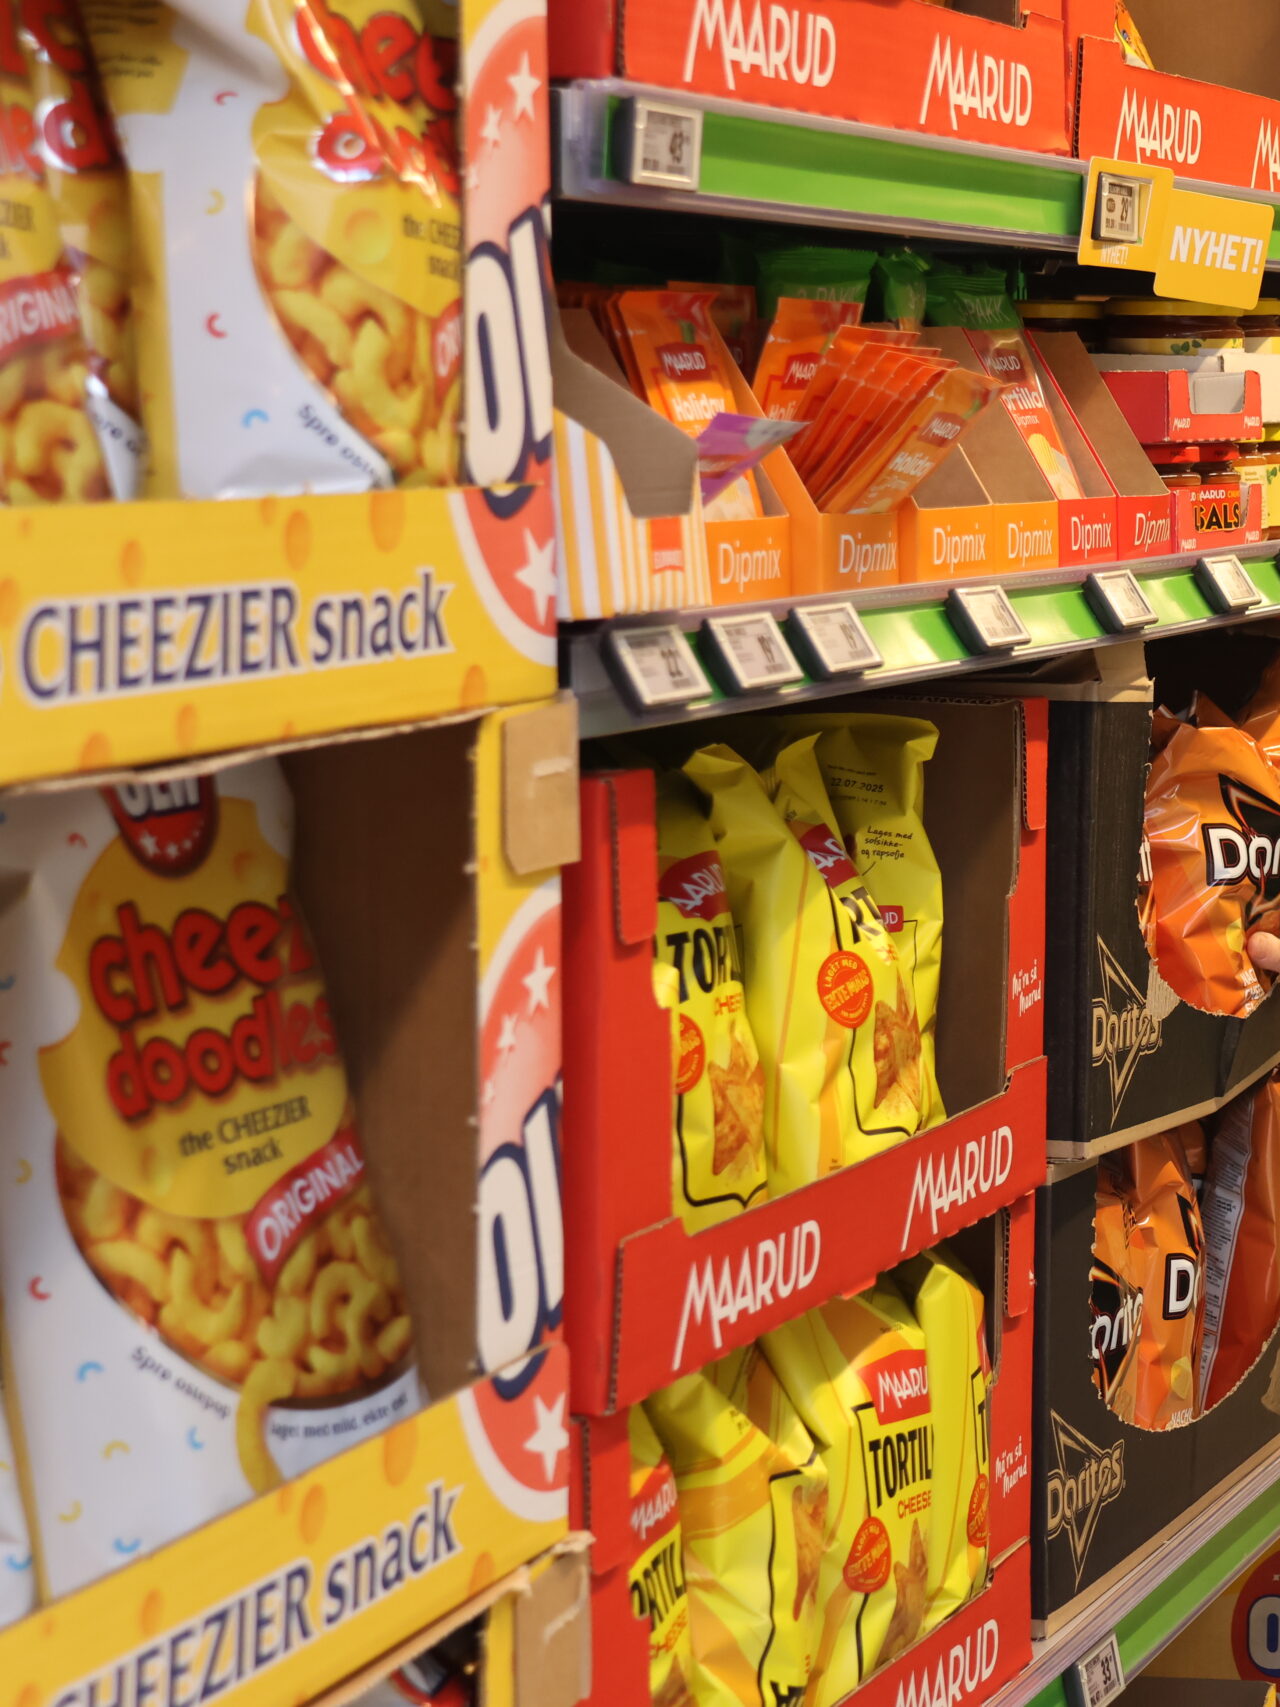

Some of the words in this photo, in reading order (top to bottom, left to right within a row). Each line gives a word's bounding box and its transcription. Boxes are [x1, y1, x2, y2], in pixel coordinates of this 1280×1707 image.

[683, 0, 837, 91] MAARUD
[919, 32, 1032, 131] MAARUD
[1113, 86, 1202, 164] MAARUD
[1101, 246, 1128, 265] NYHET!
[1168, 226, 1264, 275] NYHET!
[769, 401, 797, 421] Holi
[1002, 387, 1043, 412] ortilla
[933, 523, 987, 574] Dipmix
[1007, 521, 1054, 563] Dipmix
[1071, 506, 1112, 551] Dipmix
[1134, 506, 1171, 547] Dipmix
[1198, 502, 1240, 532] SALS
[718, 538, 782, 593] Dipmix
[838, 527, 898, 583] Dipmix
[21, 584, 301, 704] CHEEZIER
[312, 569, 450, 665] snack
[1092, 996, 1161, 1068] Doritos
[179, 1130, 214, 1158] the
[217, 1095, 313, 1145] CHEEZIER
[223, 1137, 284, 1175] snack
[257, 1145, 365, 1261] ORIGINAL
[902, 1125, 1014, 1251] MAARUD
[672, 1220, 822, 1370] MAARUD
[877, 1365, 930, 1413] MAARU
[868, 1424, 933, 1509] TORTIL
[1047, 1441, 1125, 1540] Doritos
[630, 1474, 678, 1540] MAARU
[52, 1564, 313, 1707] HEEZIER
[325, 1486, 460, 1627] snack
[893, 1619, 999, 1707] MAARUD
